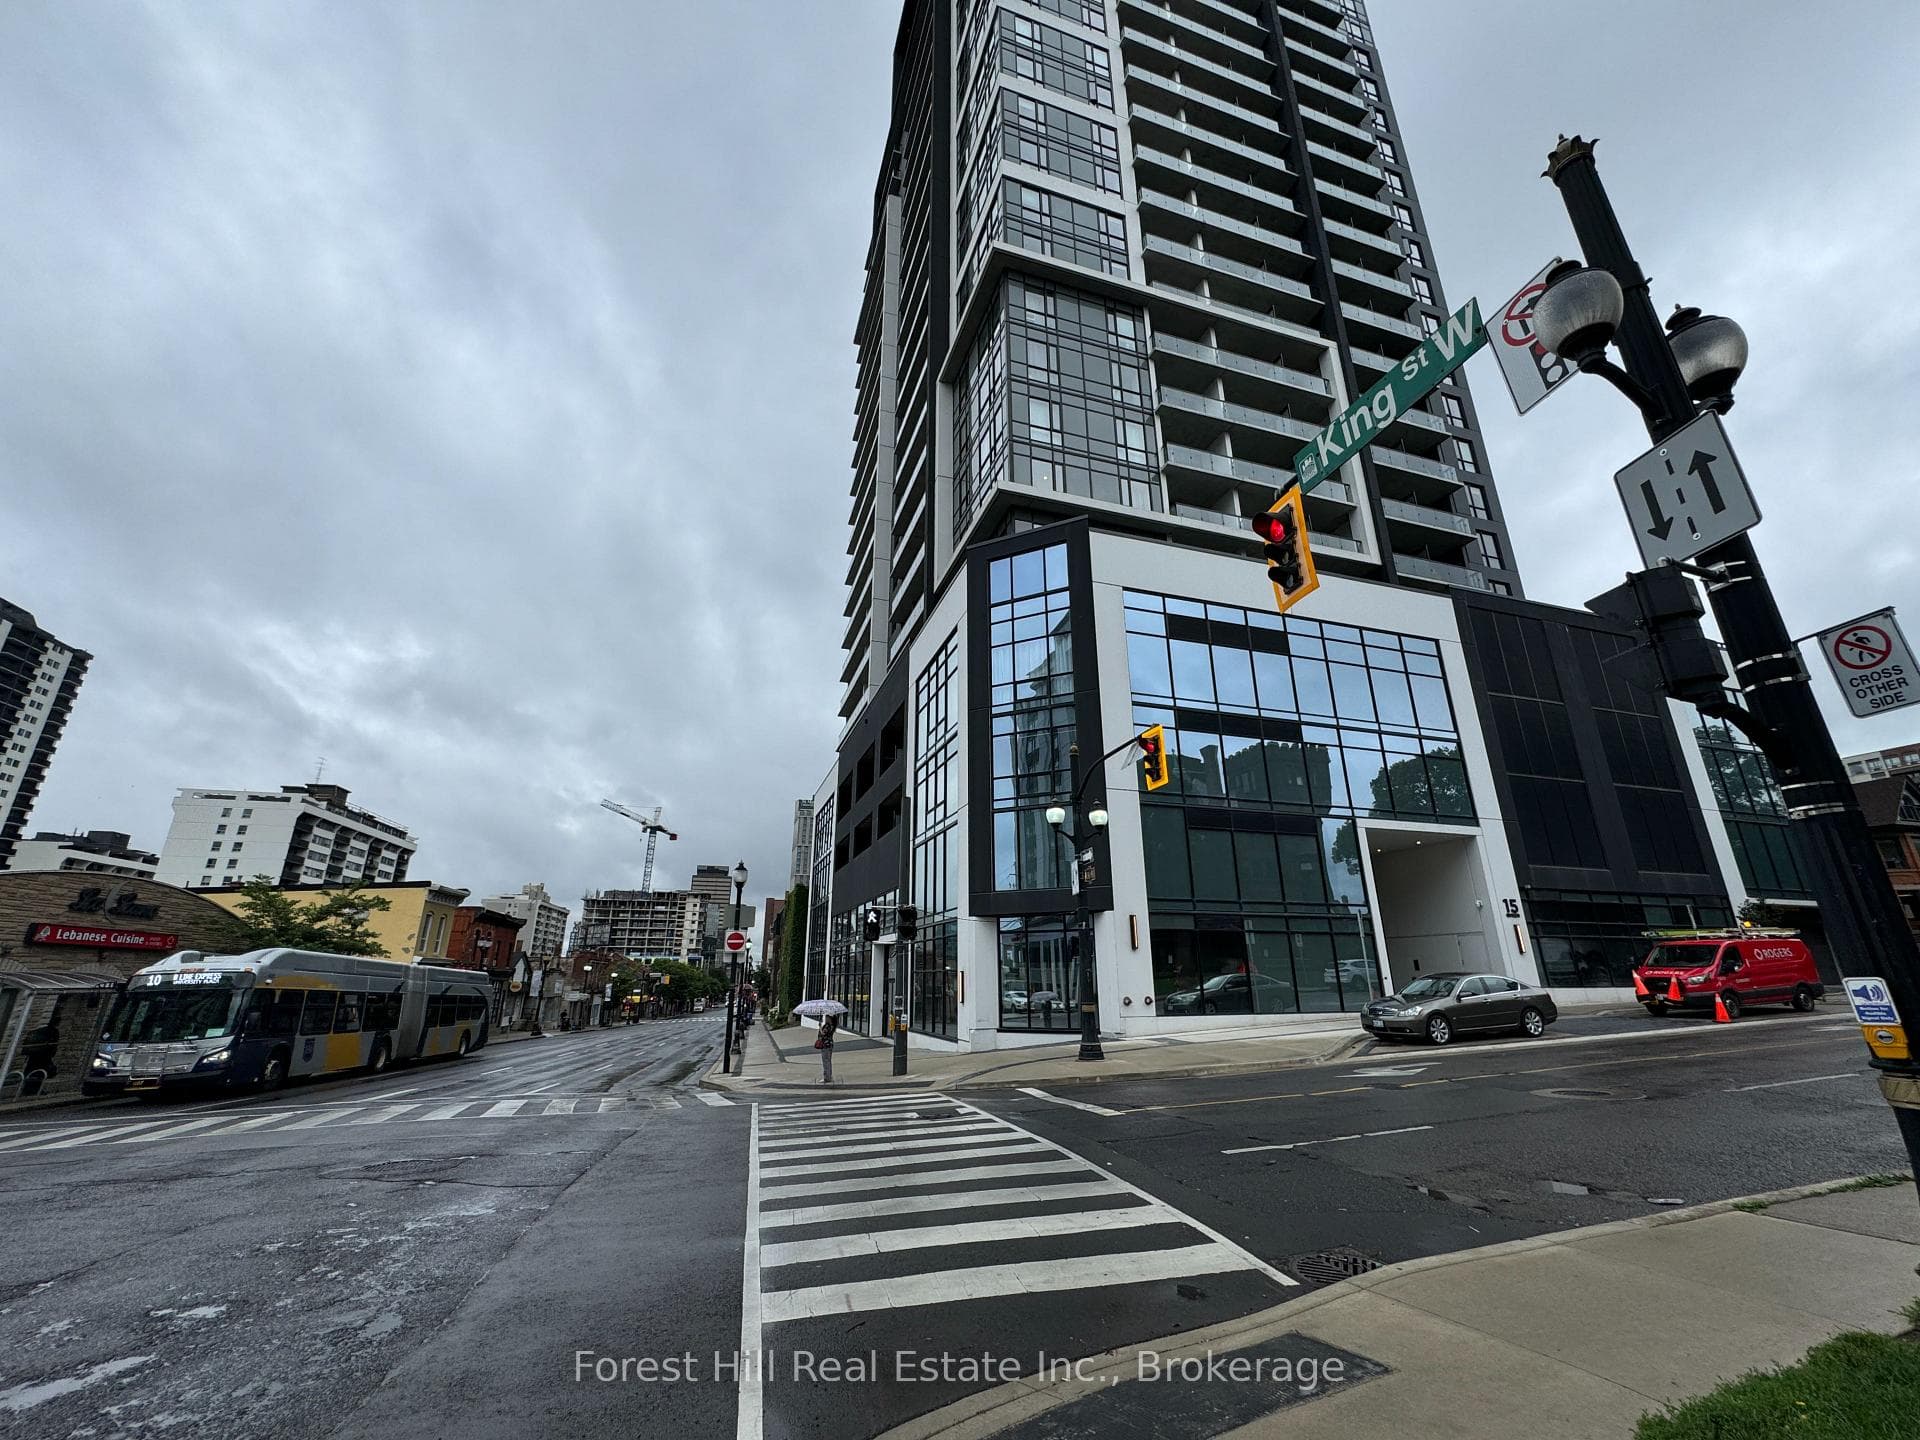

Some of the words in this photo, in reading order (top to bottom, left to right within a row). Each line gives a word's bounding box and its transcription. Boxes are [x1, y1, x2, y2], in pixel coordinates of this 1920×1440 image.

[1316, 384, 1397, 467] King
[1401, 347, 1429, 381] St
[1431, 299, 1474, 361] W
[1849, 665, 1904, 687] CROSS
[1856, 677, 1909, 699] OTHER
[1869, 691, 1906, 709] SIDE
[1502, 899, 1519, 913] 15
[56, 929, 107, 942] Lebanese
[111, 933, 145, 945] Cuisine
[1762, 947, 1793, 959] ROGERS
[146, 974, 162, 986] 10
[195, 972, 222, 980] EXPRESS
